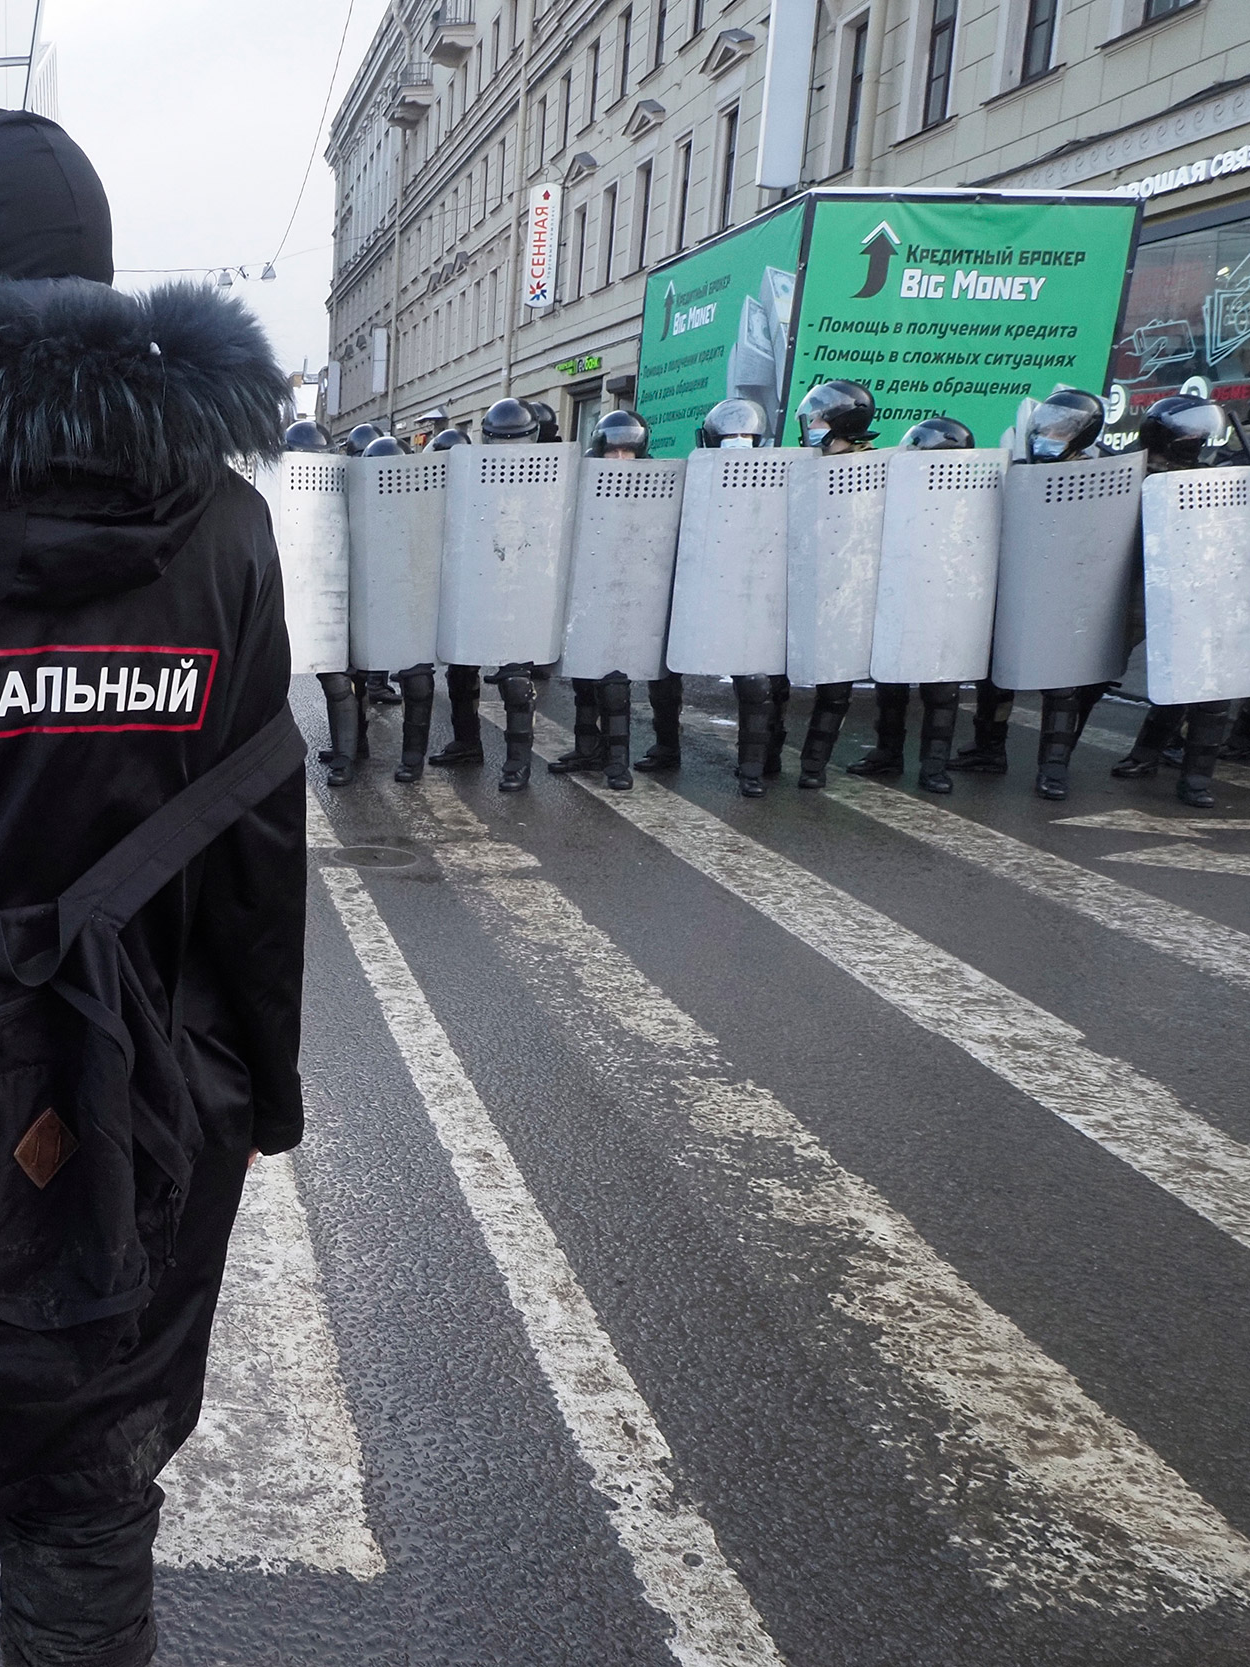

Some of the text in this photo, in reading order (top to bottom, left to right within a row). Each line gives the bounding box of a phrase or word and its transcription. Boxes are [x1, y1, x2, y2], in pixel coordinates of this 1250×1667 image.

[1210, 144, 1250, 178] СВЯ
[531, 206, 549, 279] СЕННАЯ
[900, 268, 1047, 301] BIG MONEY
[673, 302, 717, 336] BIG MONEY
[818, 316, 889, 336] Помощь
[893, 321, 902, 334] в
[906, 321, 1001, 339] получении
[1004, 323, 1078, 341] кредита
[813, 345, 885, 365] Помощь
[888, 350, 898, 363] в
[902, 350, 979, 366] сложных
[984, 352, 1077, 370] ситуациях
[874, 379, 885, 391] в
[887, 380, 929, 394] день
[932, 377, 1031, 397] обращения
